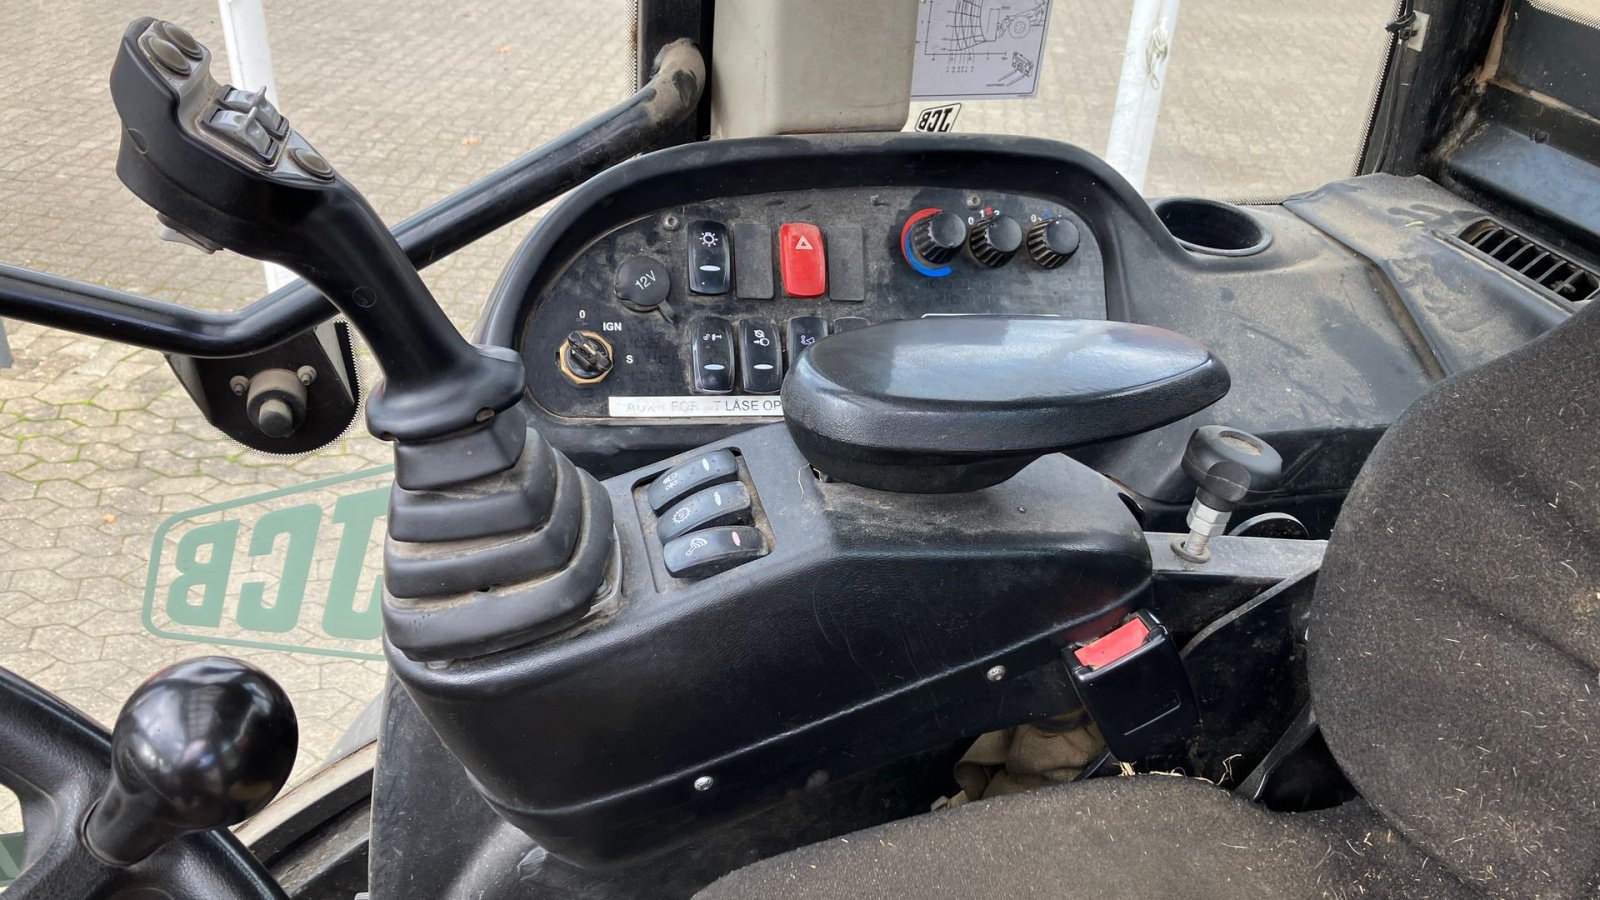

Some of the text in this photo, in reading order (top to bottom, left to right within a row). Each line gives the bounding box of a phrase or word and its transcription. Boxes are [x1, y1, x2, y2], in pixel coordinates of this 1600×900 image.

[980, 209, 985, 218] 1
[635, 270, 656, 290] 12V
[602, 322, 622, 331] IGN
[626, 355, 634, 363] S
[725, 399, 759, 412] LÅSE
[763, 400, 781, 411] OP
